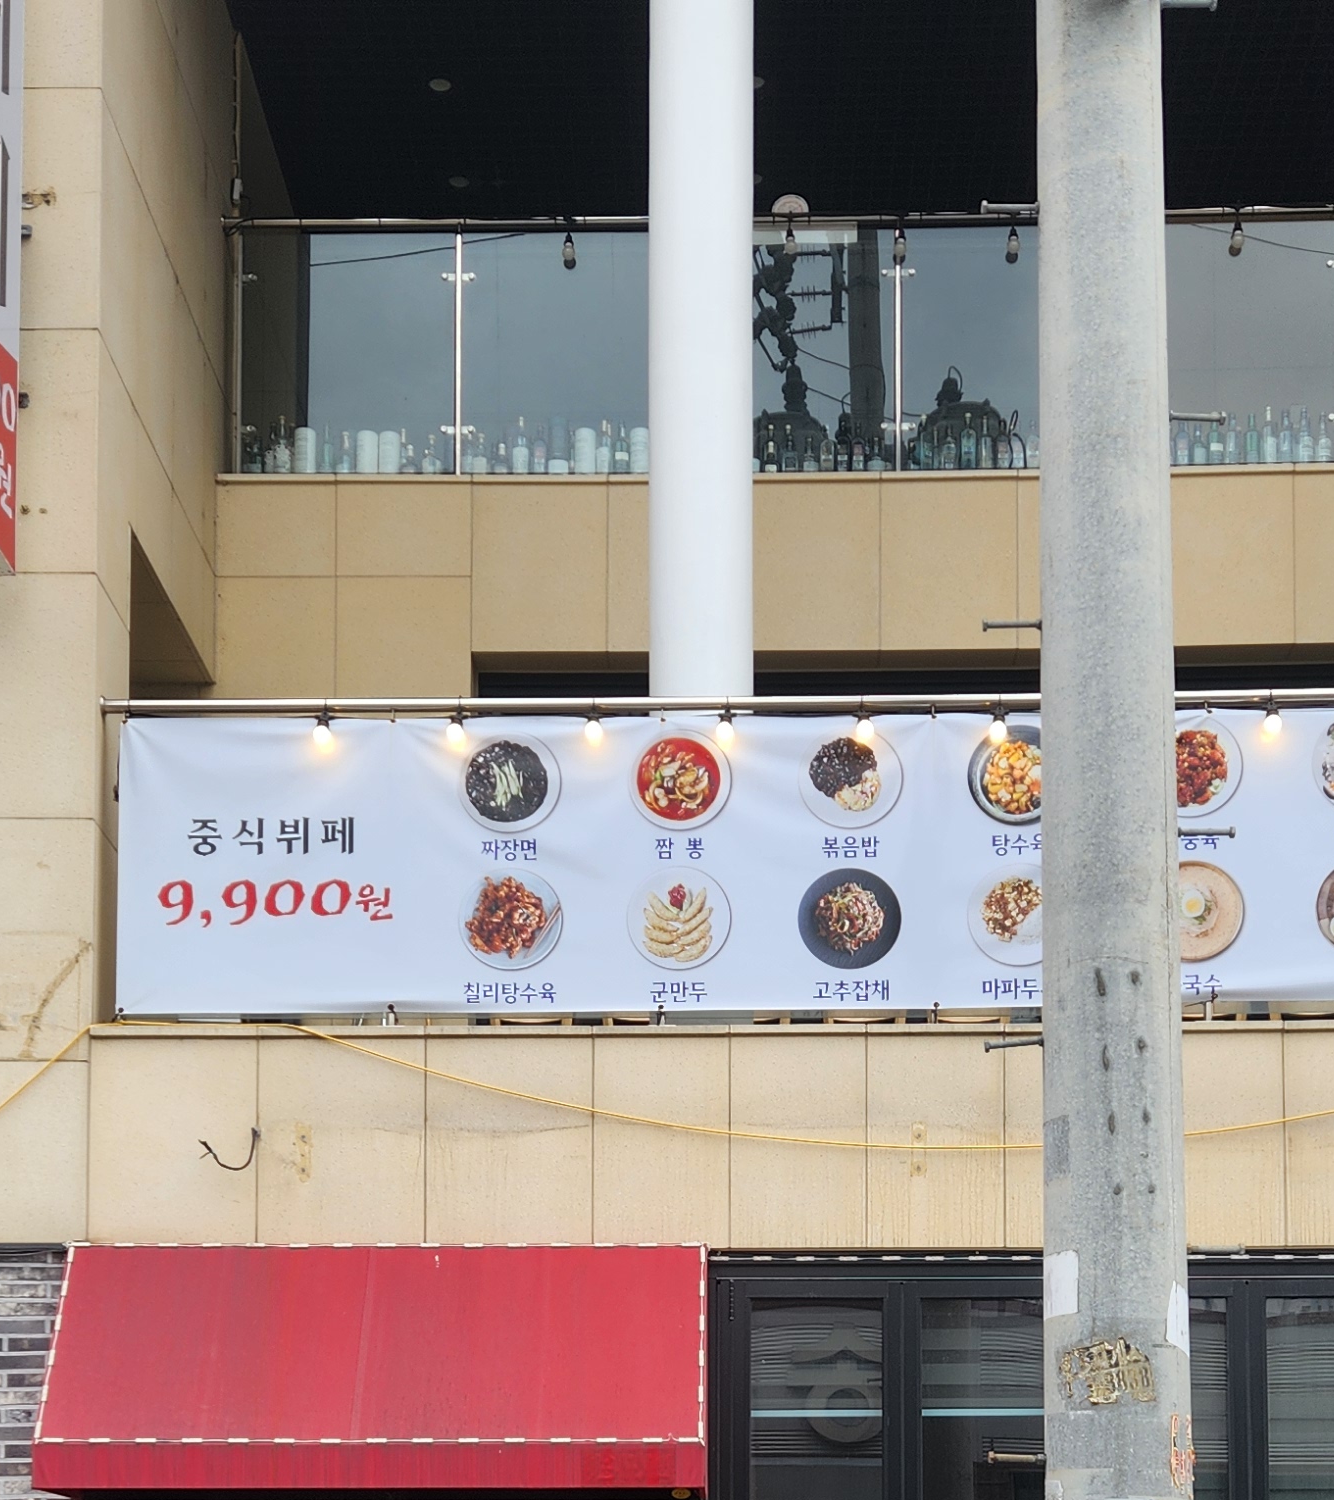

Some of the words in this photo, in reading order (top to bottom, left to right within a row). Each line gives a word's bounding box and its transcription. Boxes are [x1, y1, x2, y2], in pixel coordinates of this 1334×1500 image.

[188, 816, 357, 857] 중식뷔페
[821, 836, 880, 861] 볶음밥
[480, 837, 539, 862] 짜장면
[157, 877, 393, 929] 9,900원
[463, 980, 557, 1005] 칠리탕수육
[649, 980, 708, 1004] 군만두
[813, 978, 891, 1002] 고추잡채
[982, 978, 1042, 1000] 마파두
[1179, 974, 1223, 997] 국수
